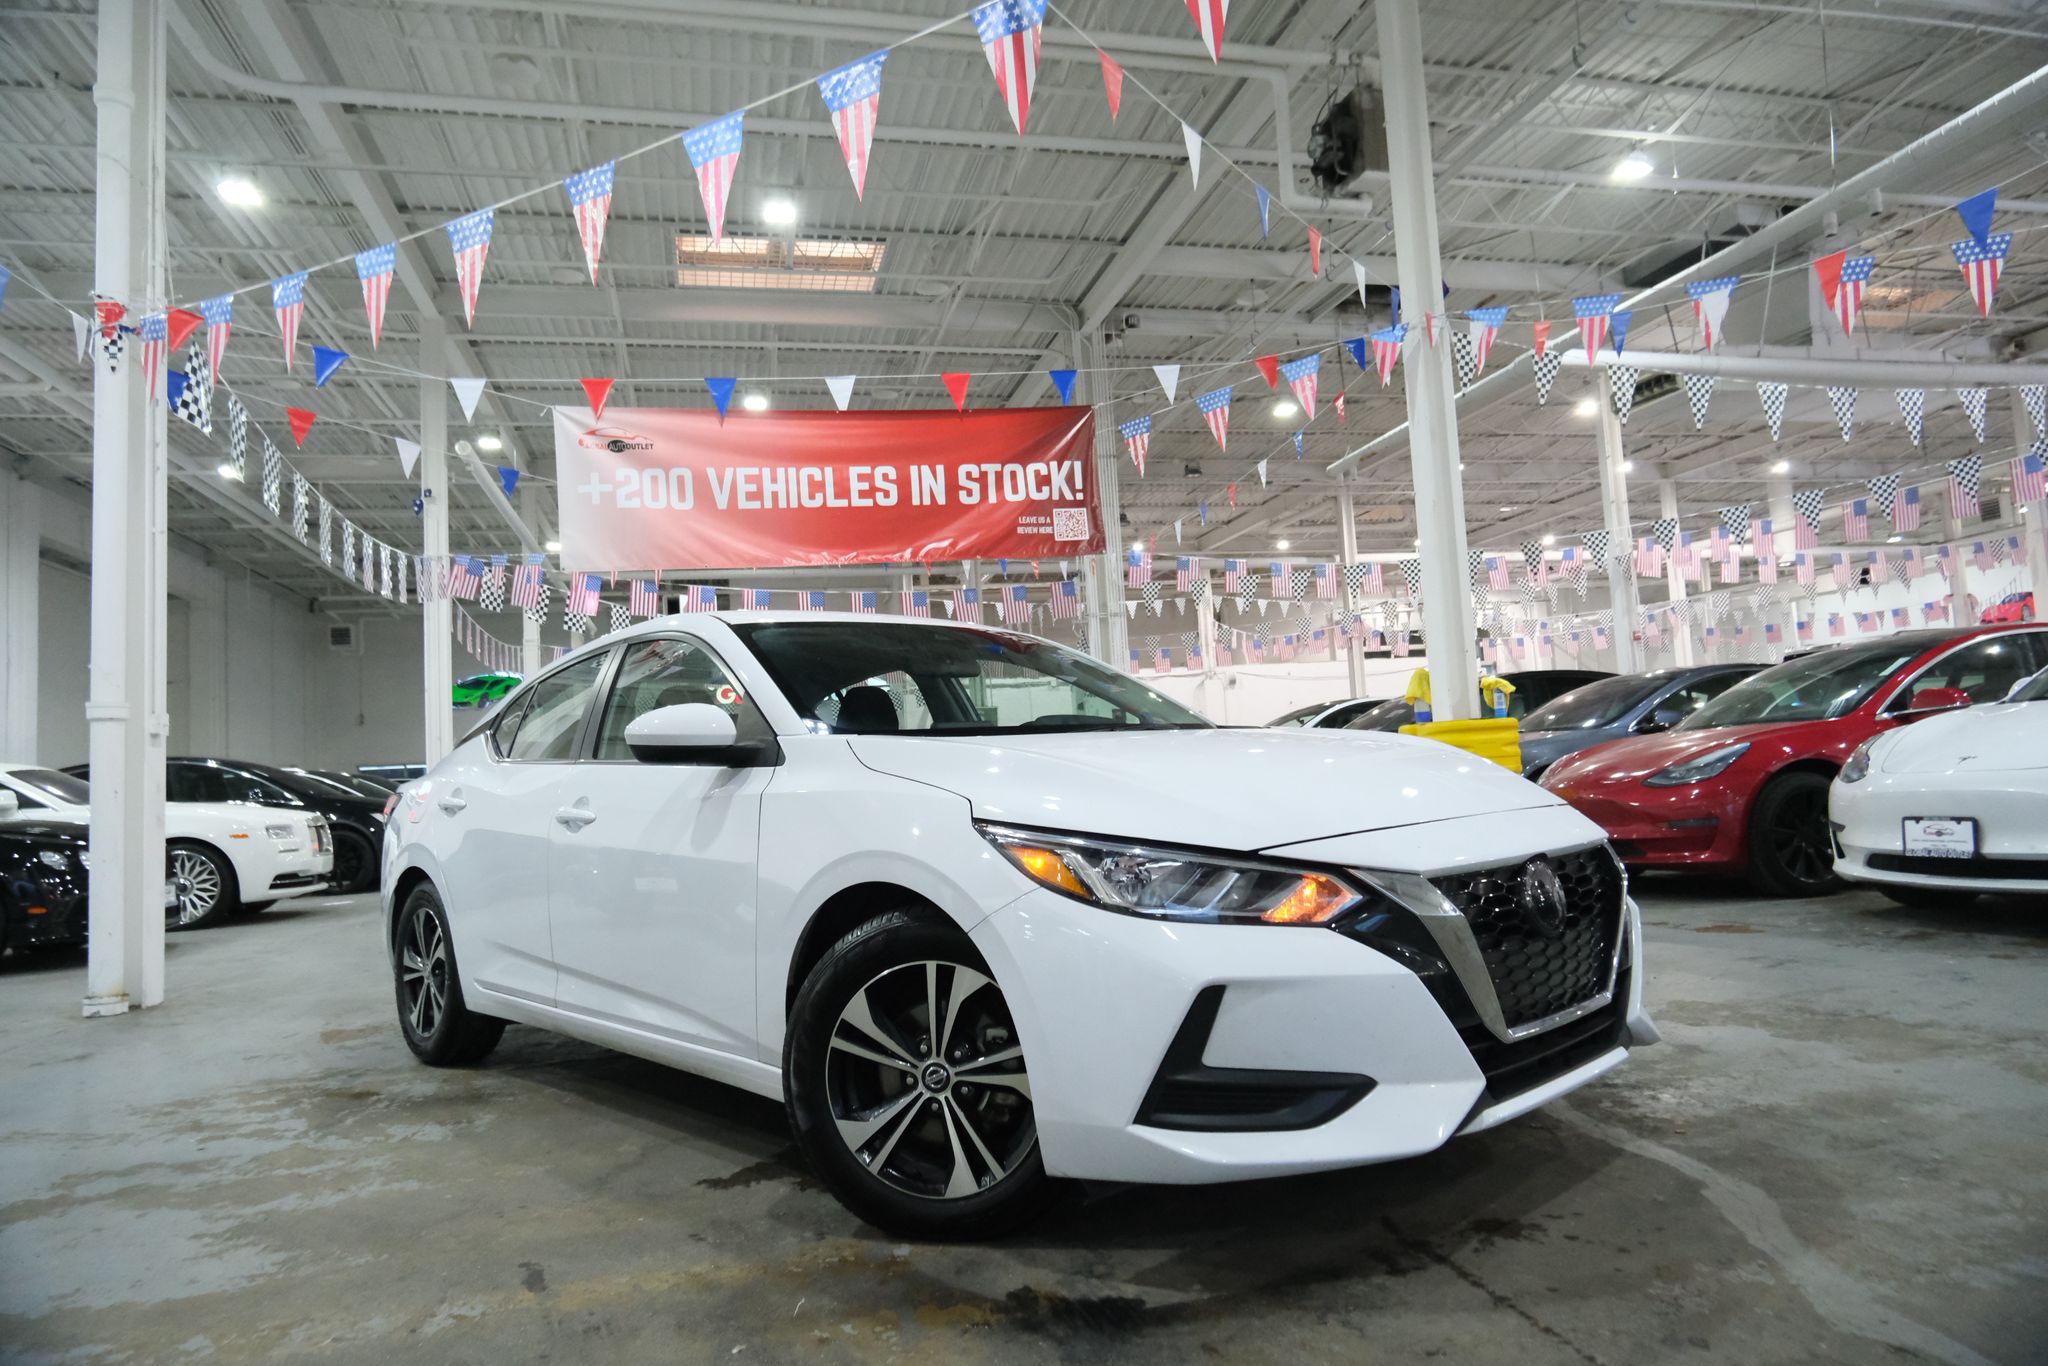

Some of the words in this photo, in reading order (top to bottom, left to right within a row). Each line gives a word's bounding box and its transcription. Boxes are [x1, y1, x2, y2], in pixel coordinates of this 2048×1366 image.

[577, 466, 694, 511] +200
[706, 465, 898, 510] VEHICLES
[910, 464, 946, 506] IN
[957, 460, 1084, 505] STOCK!
[1018, 516, 1038, 524] LEAVE
[1017, 526, 1038, 534] REVIEW
[1039, 526, 1053, 534] HERE
